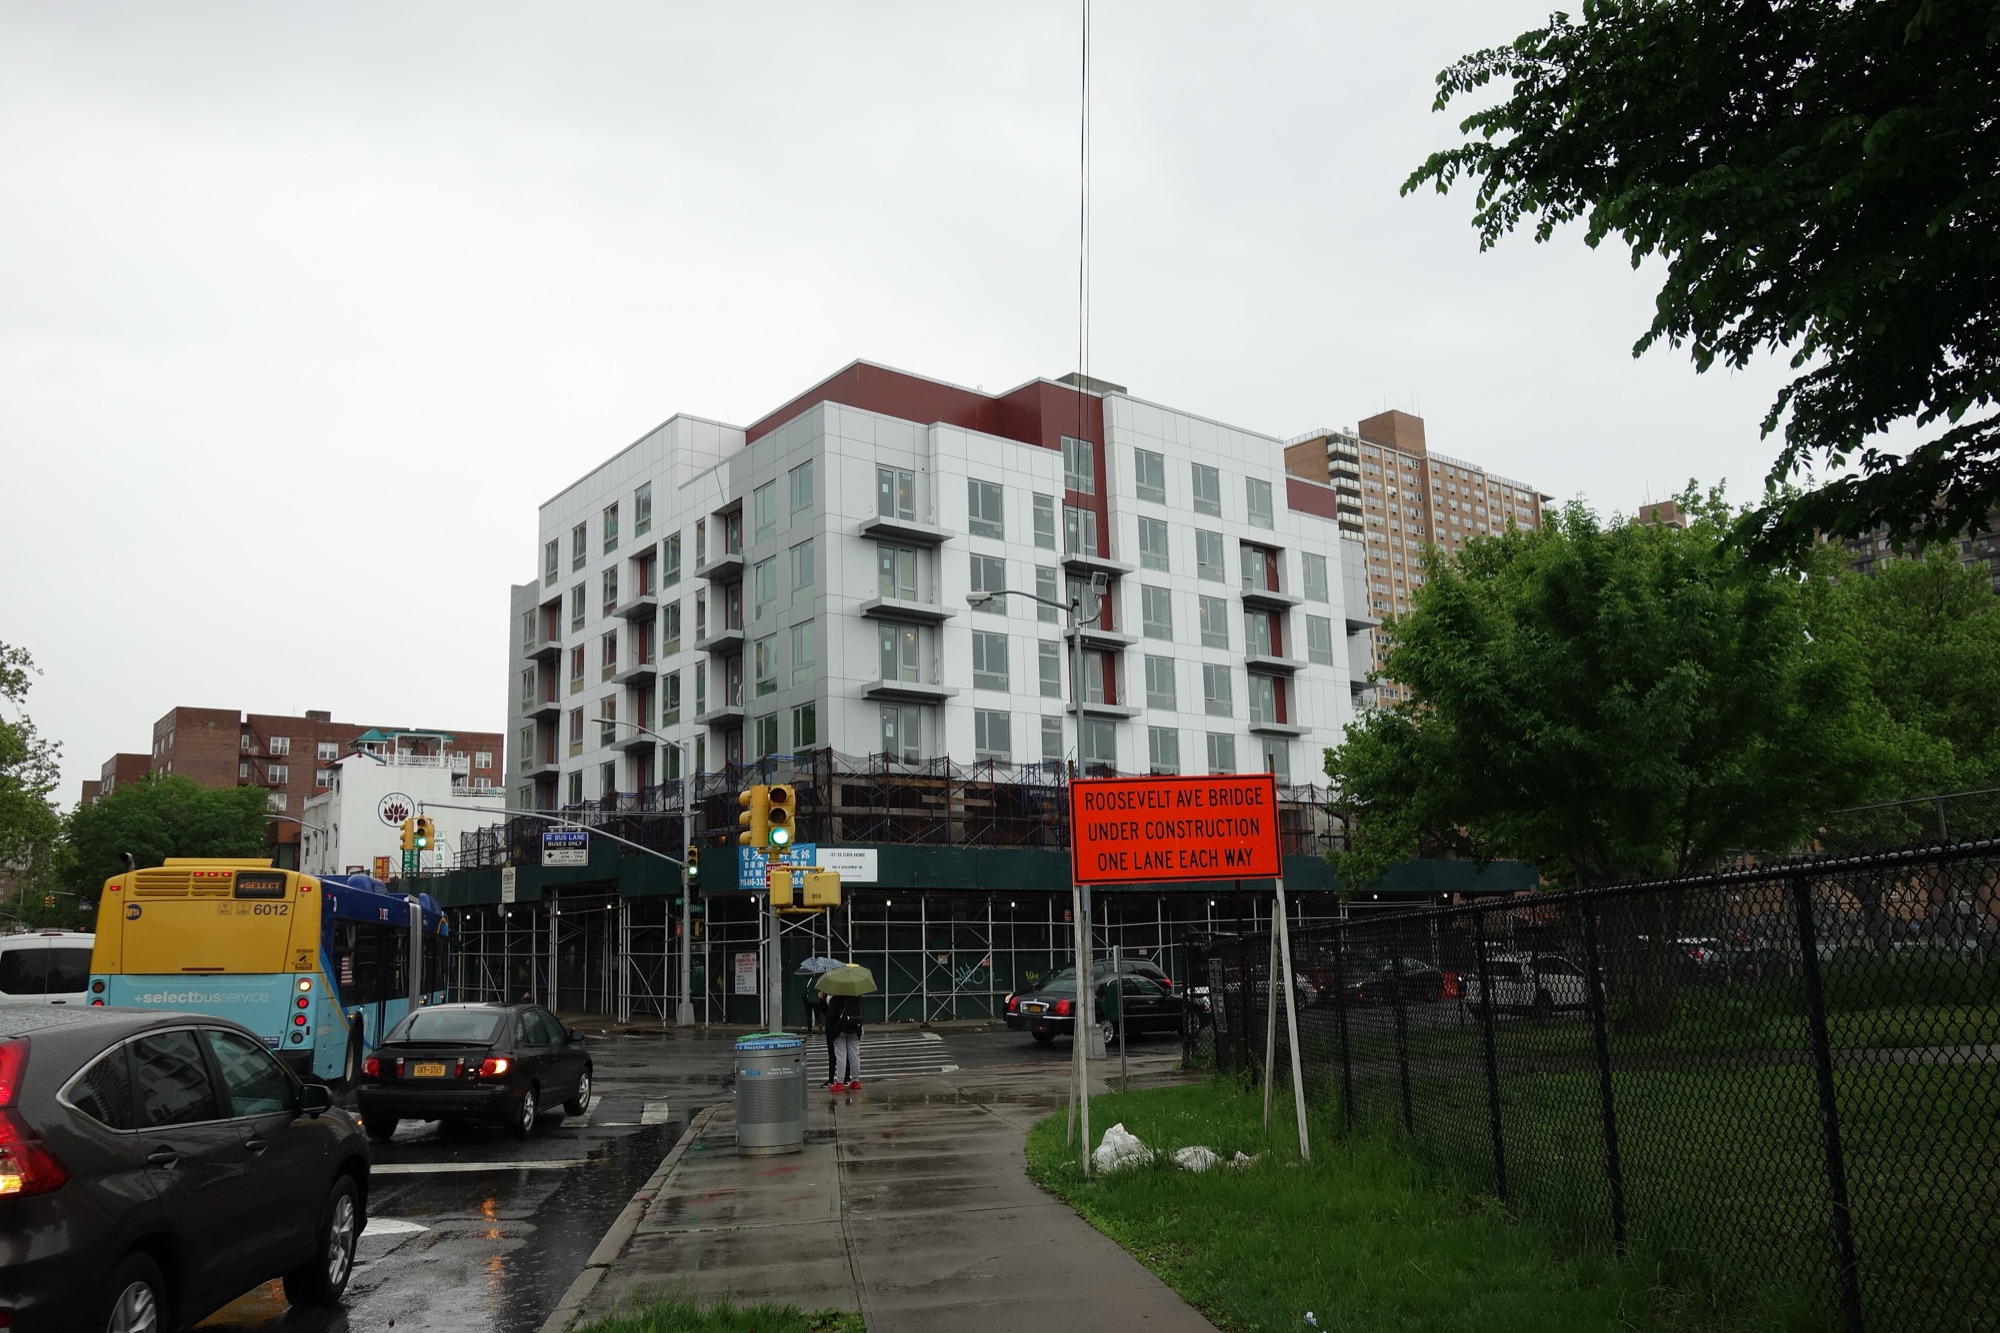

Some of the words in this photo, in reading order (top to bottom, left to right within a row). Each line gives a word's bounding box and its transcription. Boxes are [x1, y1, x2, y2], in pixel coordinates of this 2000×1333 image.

[1085, 790, 1171, 810] ROOSEVELT
[1176, 789, 1203, 808] AVE
[1209, 787, 1263, 806] BRIDGE
[1088, 822, 1139, 841] UNDER
[1146, 818, 1260, 839] CONSTRUCTION
[1098, 852, 1128, 871] ONE
[1134, 850, 1173, 870] LANE
[1179, 849, 1218, 869] EACH
[1224, 848, 1253, 867] WAY
[254, 904, 287, 915] 6012
